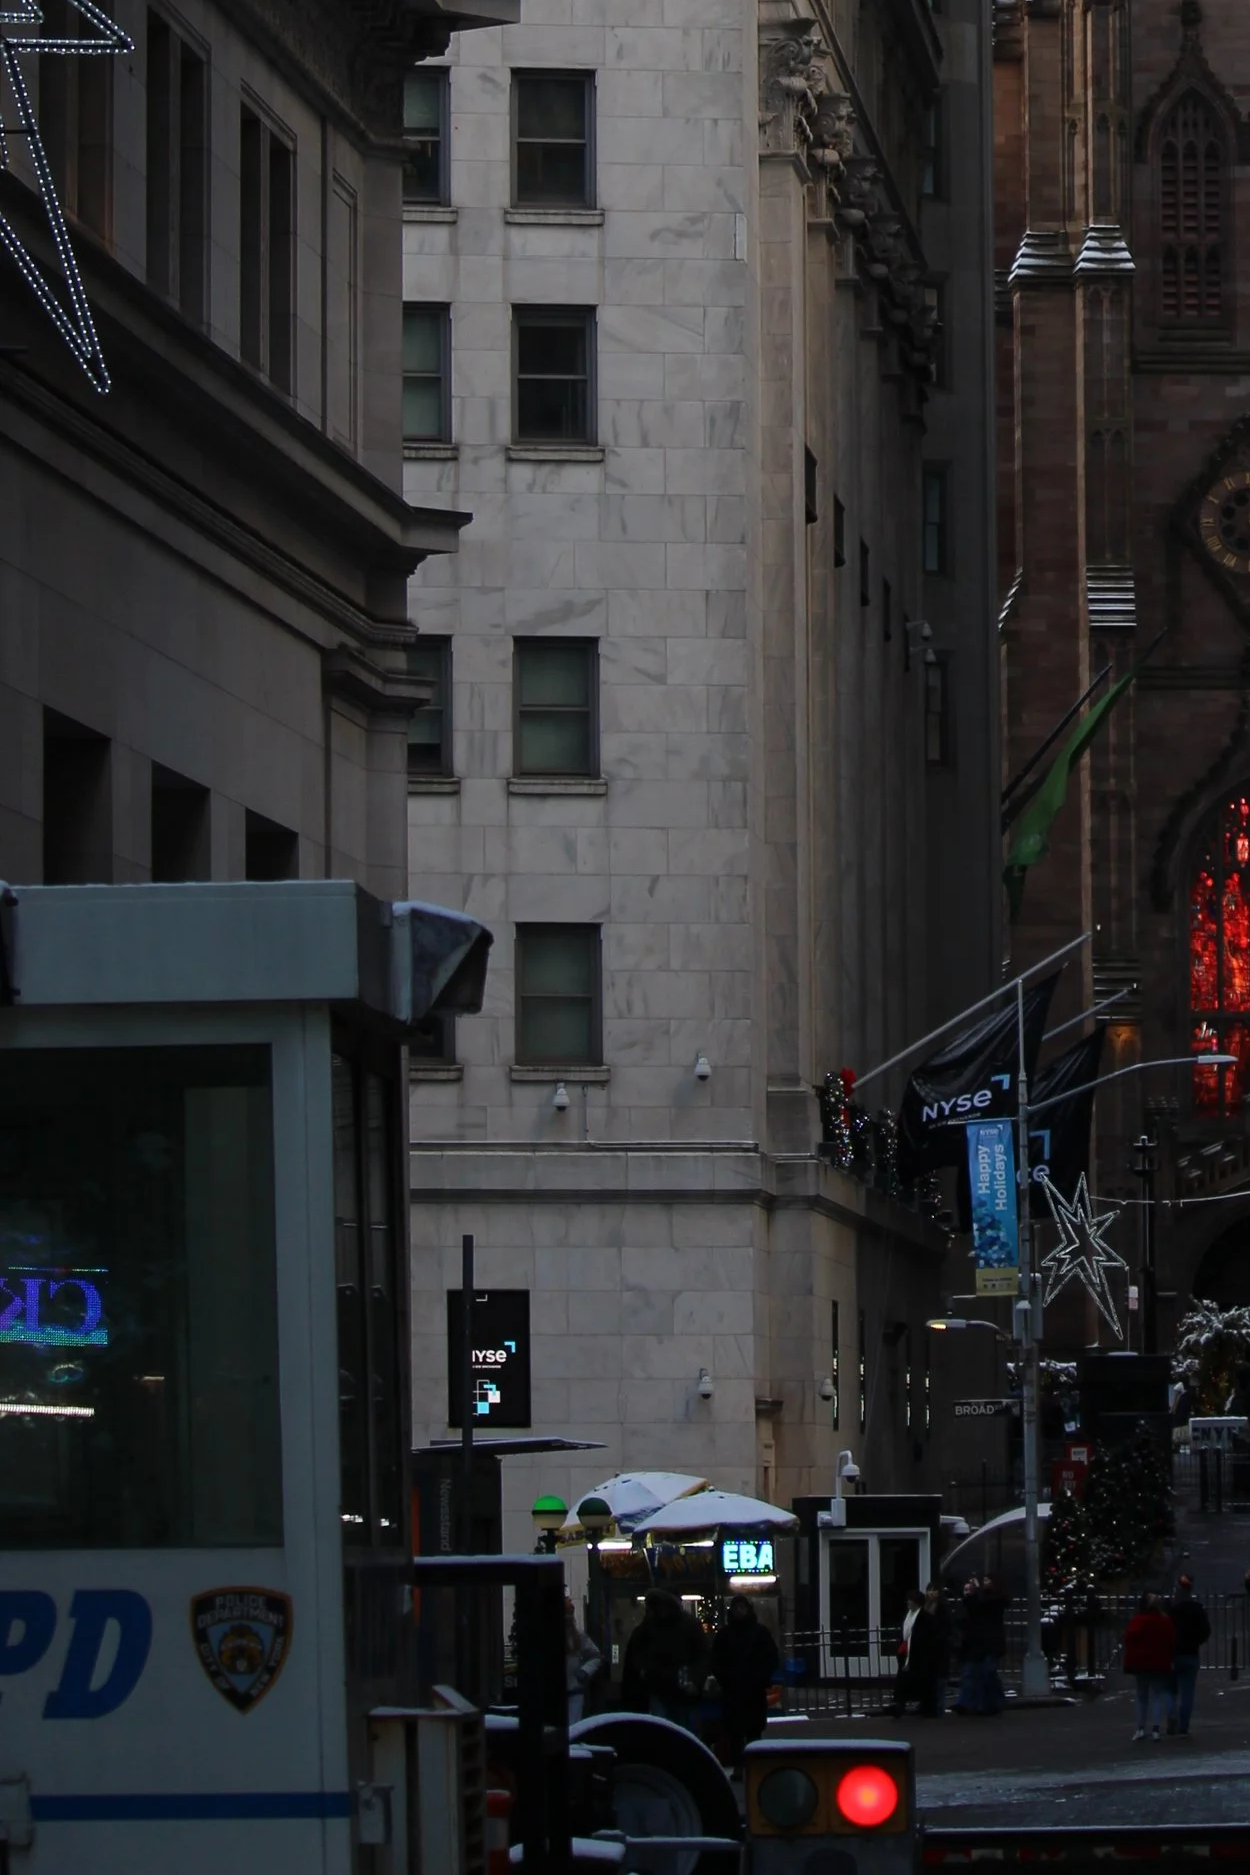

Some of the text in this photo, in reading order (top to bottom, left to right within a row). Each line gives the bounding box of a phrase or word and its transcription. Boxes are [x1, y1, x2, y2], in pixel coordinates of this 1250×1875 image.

[922, 1089, 993, 1122] NYSE
[977, 1145, 992, 1194] Happy
[993, 1144, 1008, 1211] Holidays
[955, 1405, 995, 1416] BROAD
[439, 1478, 452, 1551] Newsstand
[197, 1605, 285, 1630] DEPARTMENT
[214, 1593, 268, 1609] POLICE
